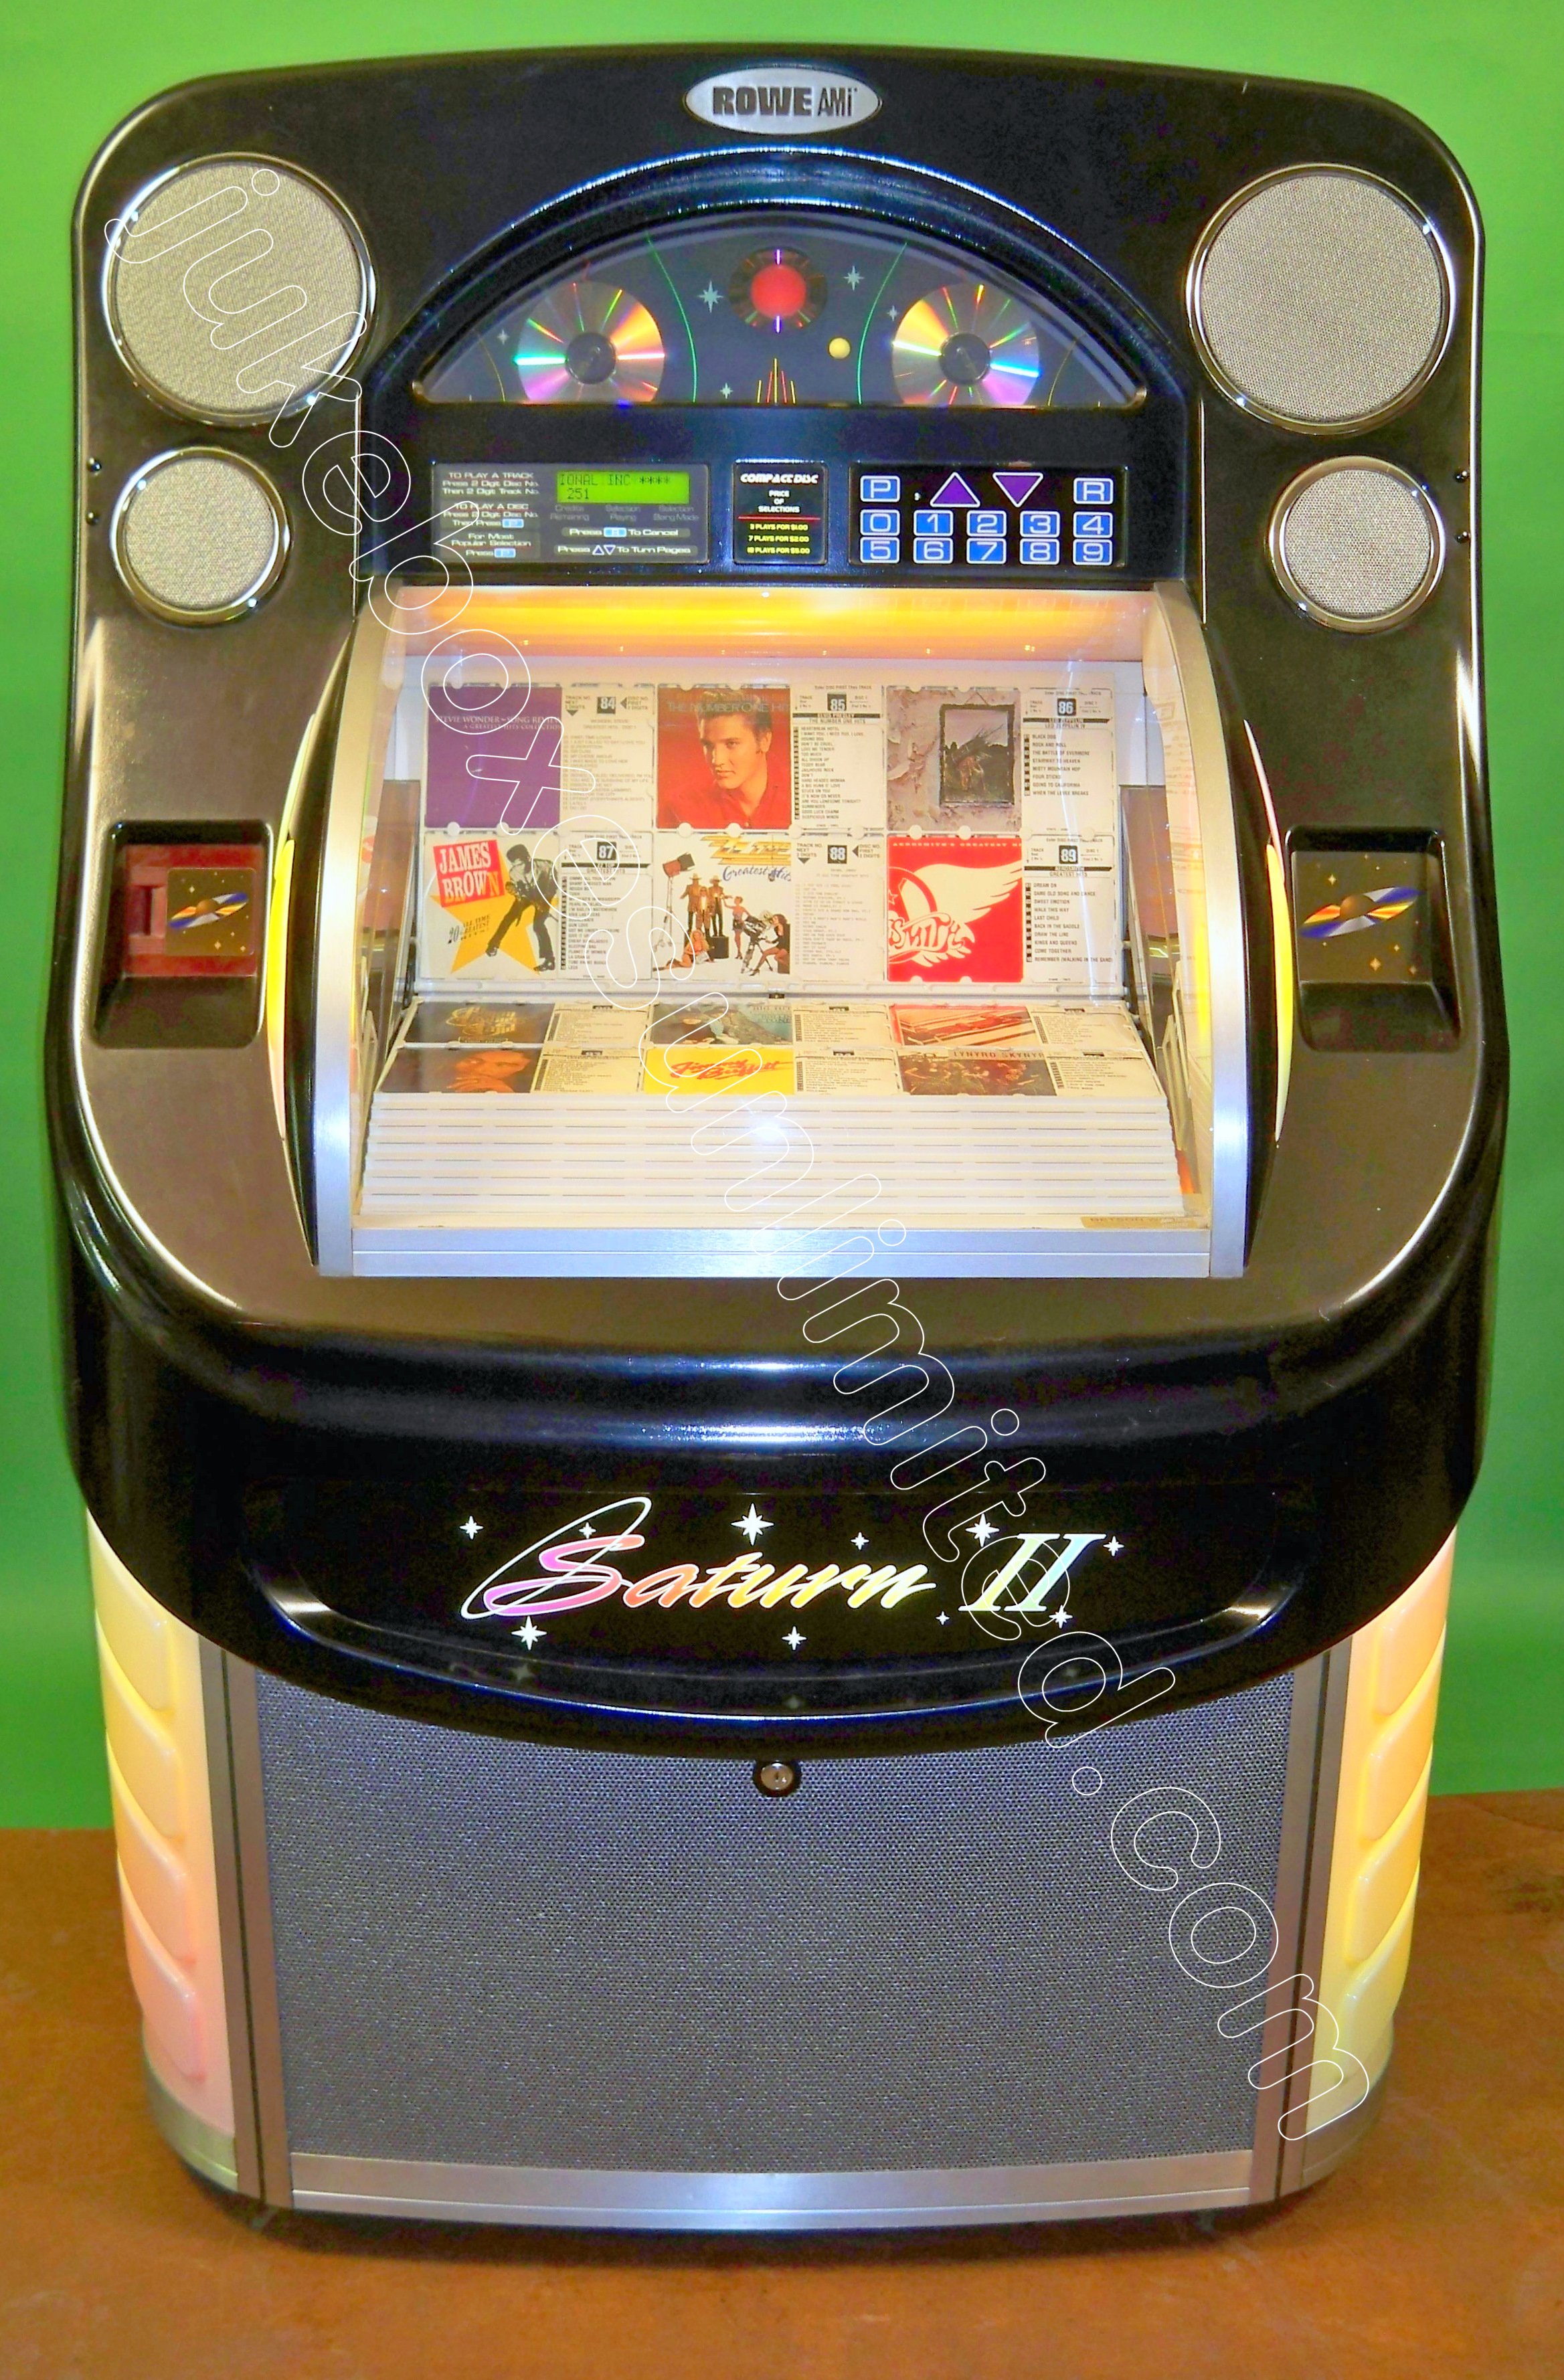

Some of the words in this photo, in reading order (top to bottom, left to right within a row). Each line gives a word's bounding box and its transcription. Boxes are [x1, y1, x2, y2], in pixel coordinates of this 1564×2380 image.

[713, 87, 812, 115] ROWE
[560, 474, 598, 486] IONAL
[608, 474, 631, 486] INC
[740, 474, 793, 483] COMPACT
[794, 474, 818, 484] DISC
[567, 488, 589, 499] 251
[870, 479, 891, 498] P
[1083, 482, 1104, 501] R
[870, 513, 891, 532] 0
[926, 513, 938, 533] 1
[976, 515, 998, 533] 2
[1030, 515, 1051, 534] 3
[1082, 516, 1104, 535] 4
[657, 547, 691, 555] Pages
[870, 541, 891, 559] 5
[924, 541, 944, 560] 6
[976, 542, 998, 561] 7
[1030, 543, 1051, 561] 8
[1083, 543, 1104, 562] 9
[600, 697, 615, 709] 84
[690, 703, 737, 712] NUMBER
[741, 703, 769, 712] ONE
[830, 699, 845, 711] 85
[1059, 701, 1073, 714] 86
[440, 842, 491, 874] JAMES
[598, 846, 614, 859] 87
[831, 847, 845, 860] 88
[1061, 849, 1076, 862] 89
[723, 866, 767, 881] Greatest
[442, 870, 499, 902] BROWN
[460, 1496, 937, 1619] Saturn
[958, 1532, 1106, 1612] II
